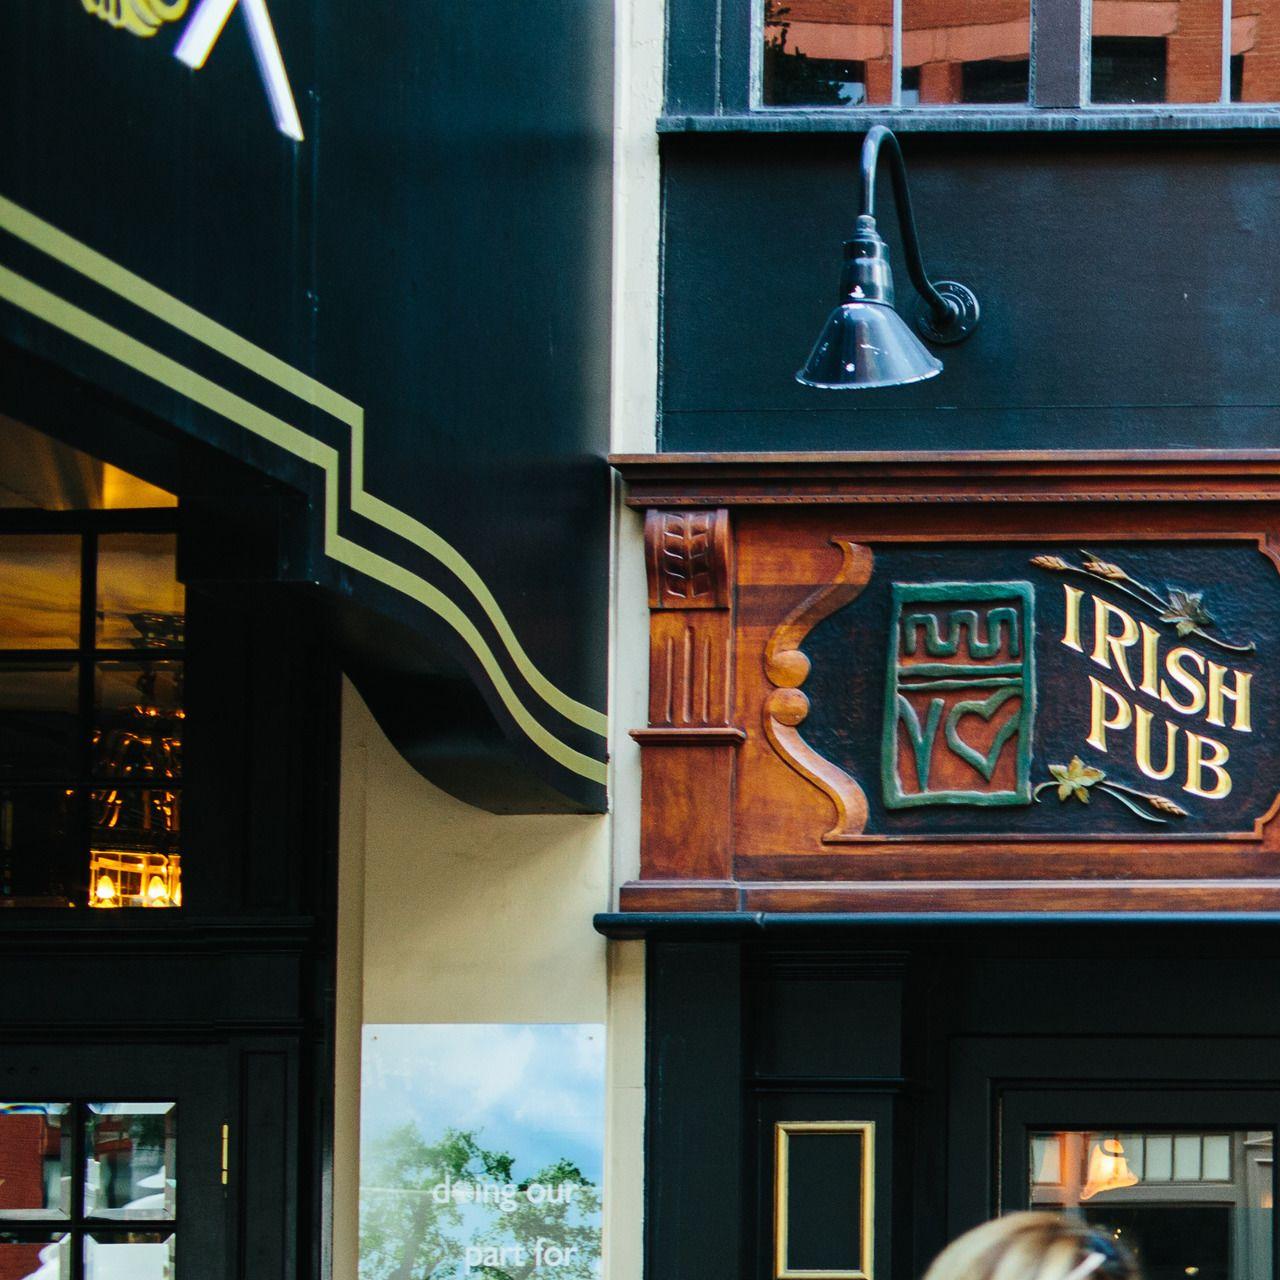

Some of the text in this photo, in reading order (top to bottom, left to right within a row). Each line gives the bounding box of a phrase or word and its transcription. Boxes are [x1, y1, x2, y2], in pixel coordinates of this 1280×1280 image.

[1060, 583, 1254, 734] IRISH
[1084, 675, 1233, 801] PUB
[432, 1174, 579, 1213] doing our
[464, 1236, 578, 1275] part for
